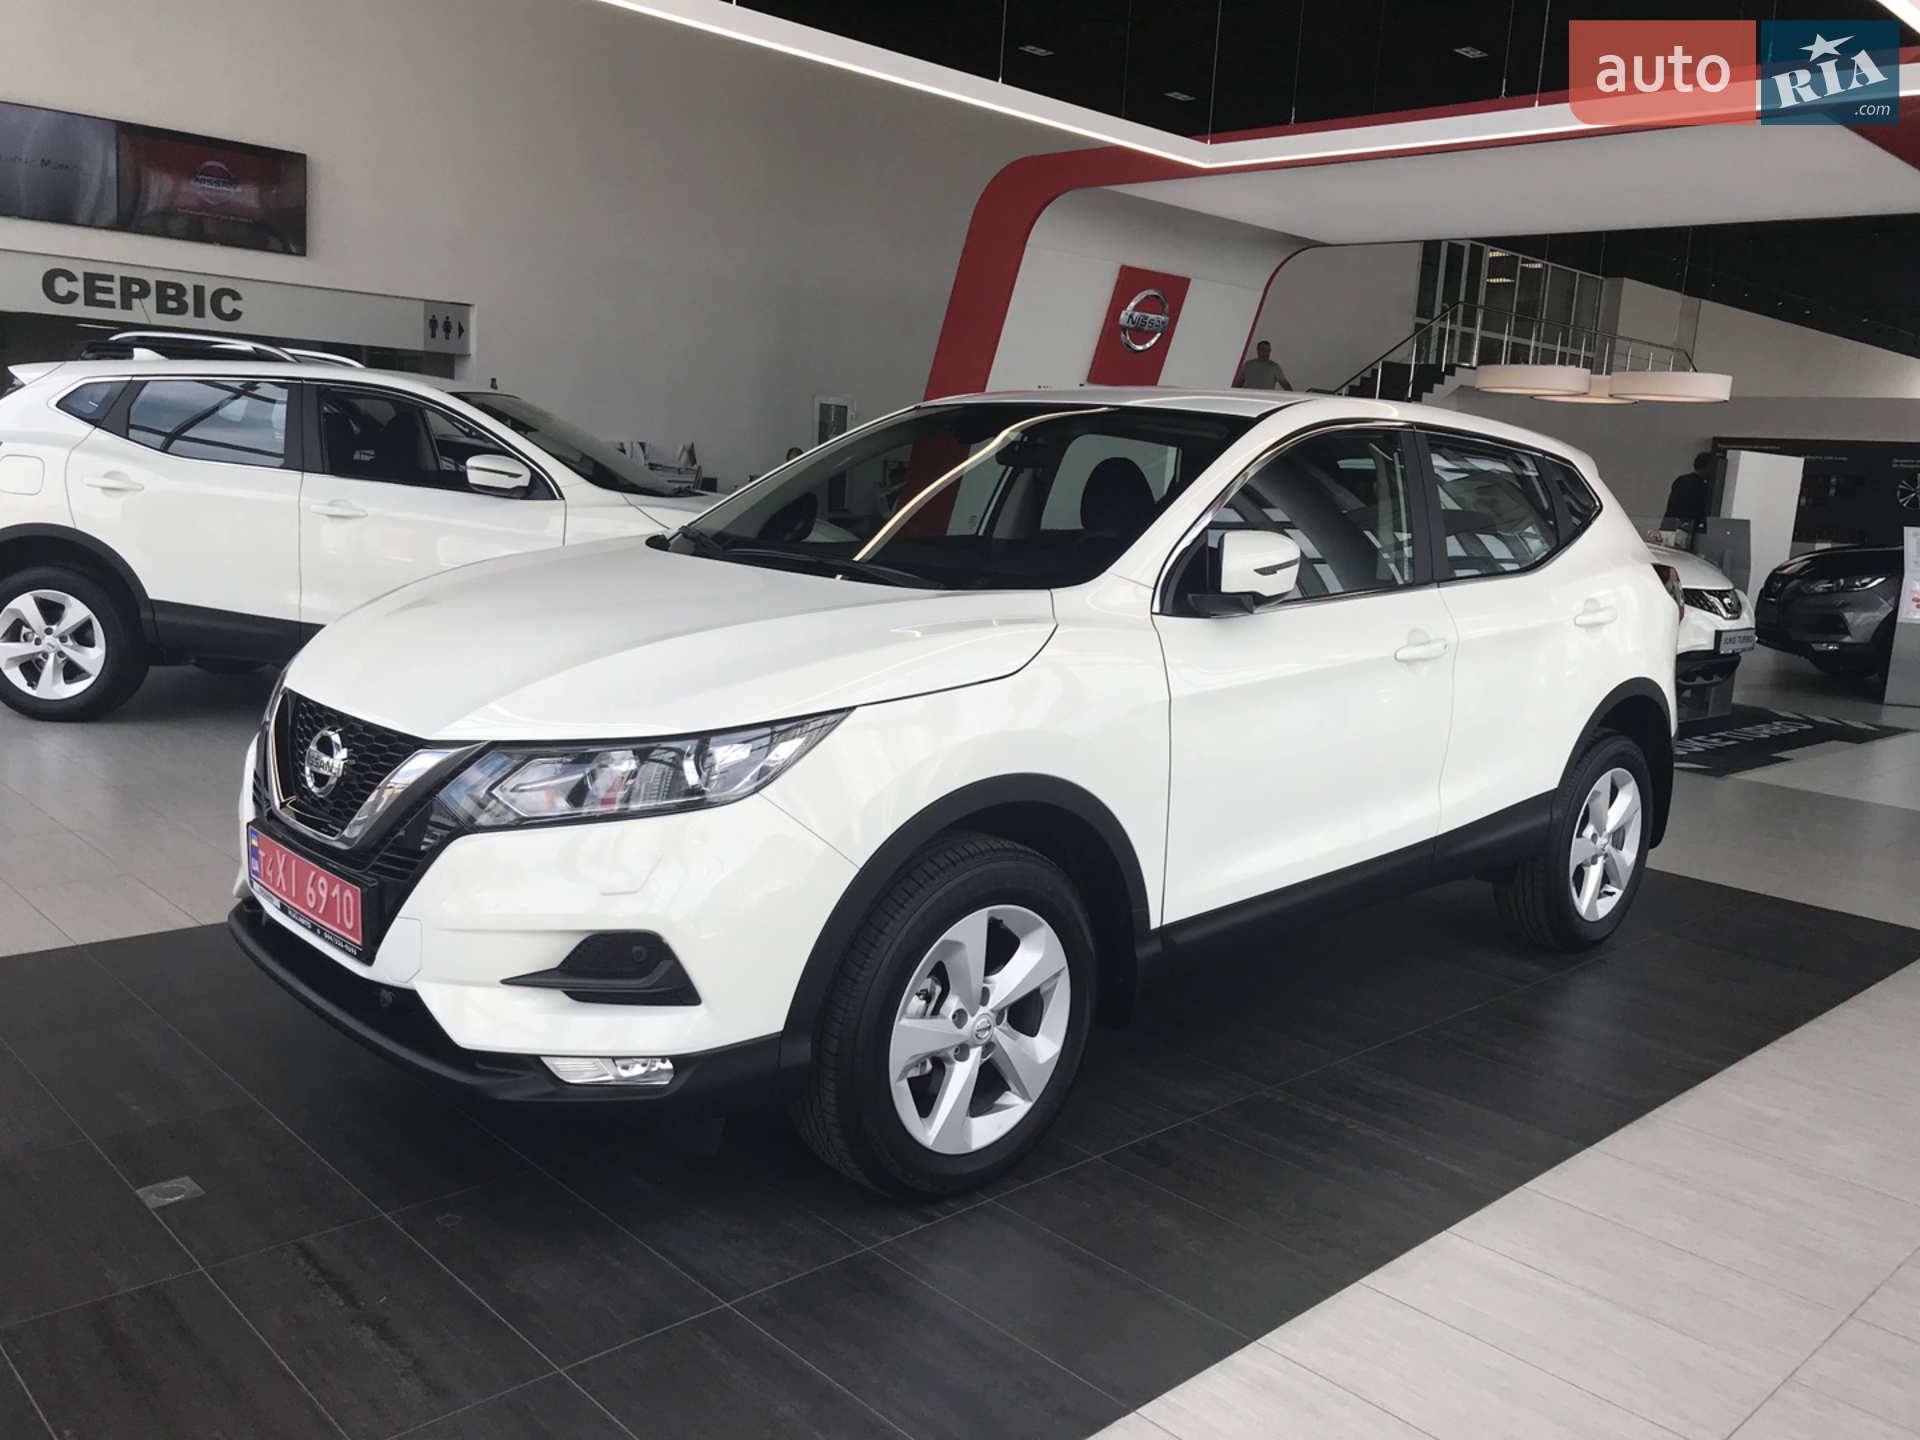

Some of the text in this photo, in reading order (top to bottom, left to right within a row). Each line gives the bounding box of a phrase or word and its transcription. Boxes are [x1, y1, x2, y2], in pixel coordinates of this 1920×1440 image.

[41, 267, 244, 322] СЕРВІС
[1126, 313, 1167, 331] NISSAN
[305, 870, 355, 931] 6910
